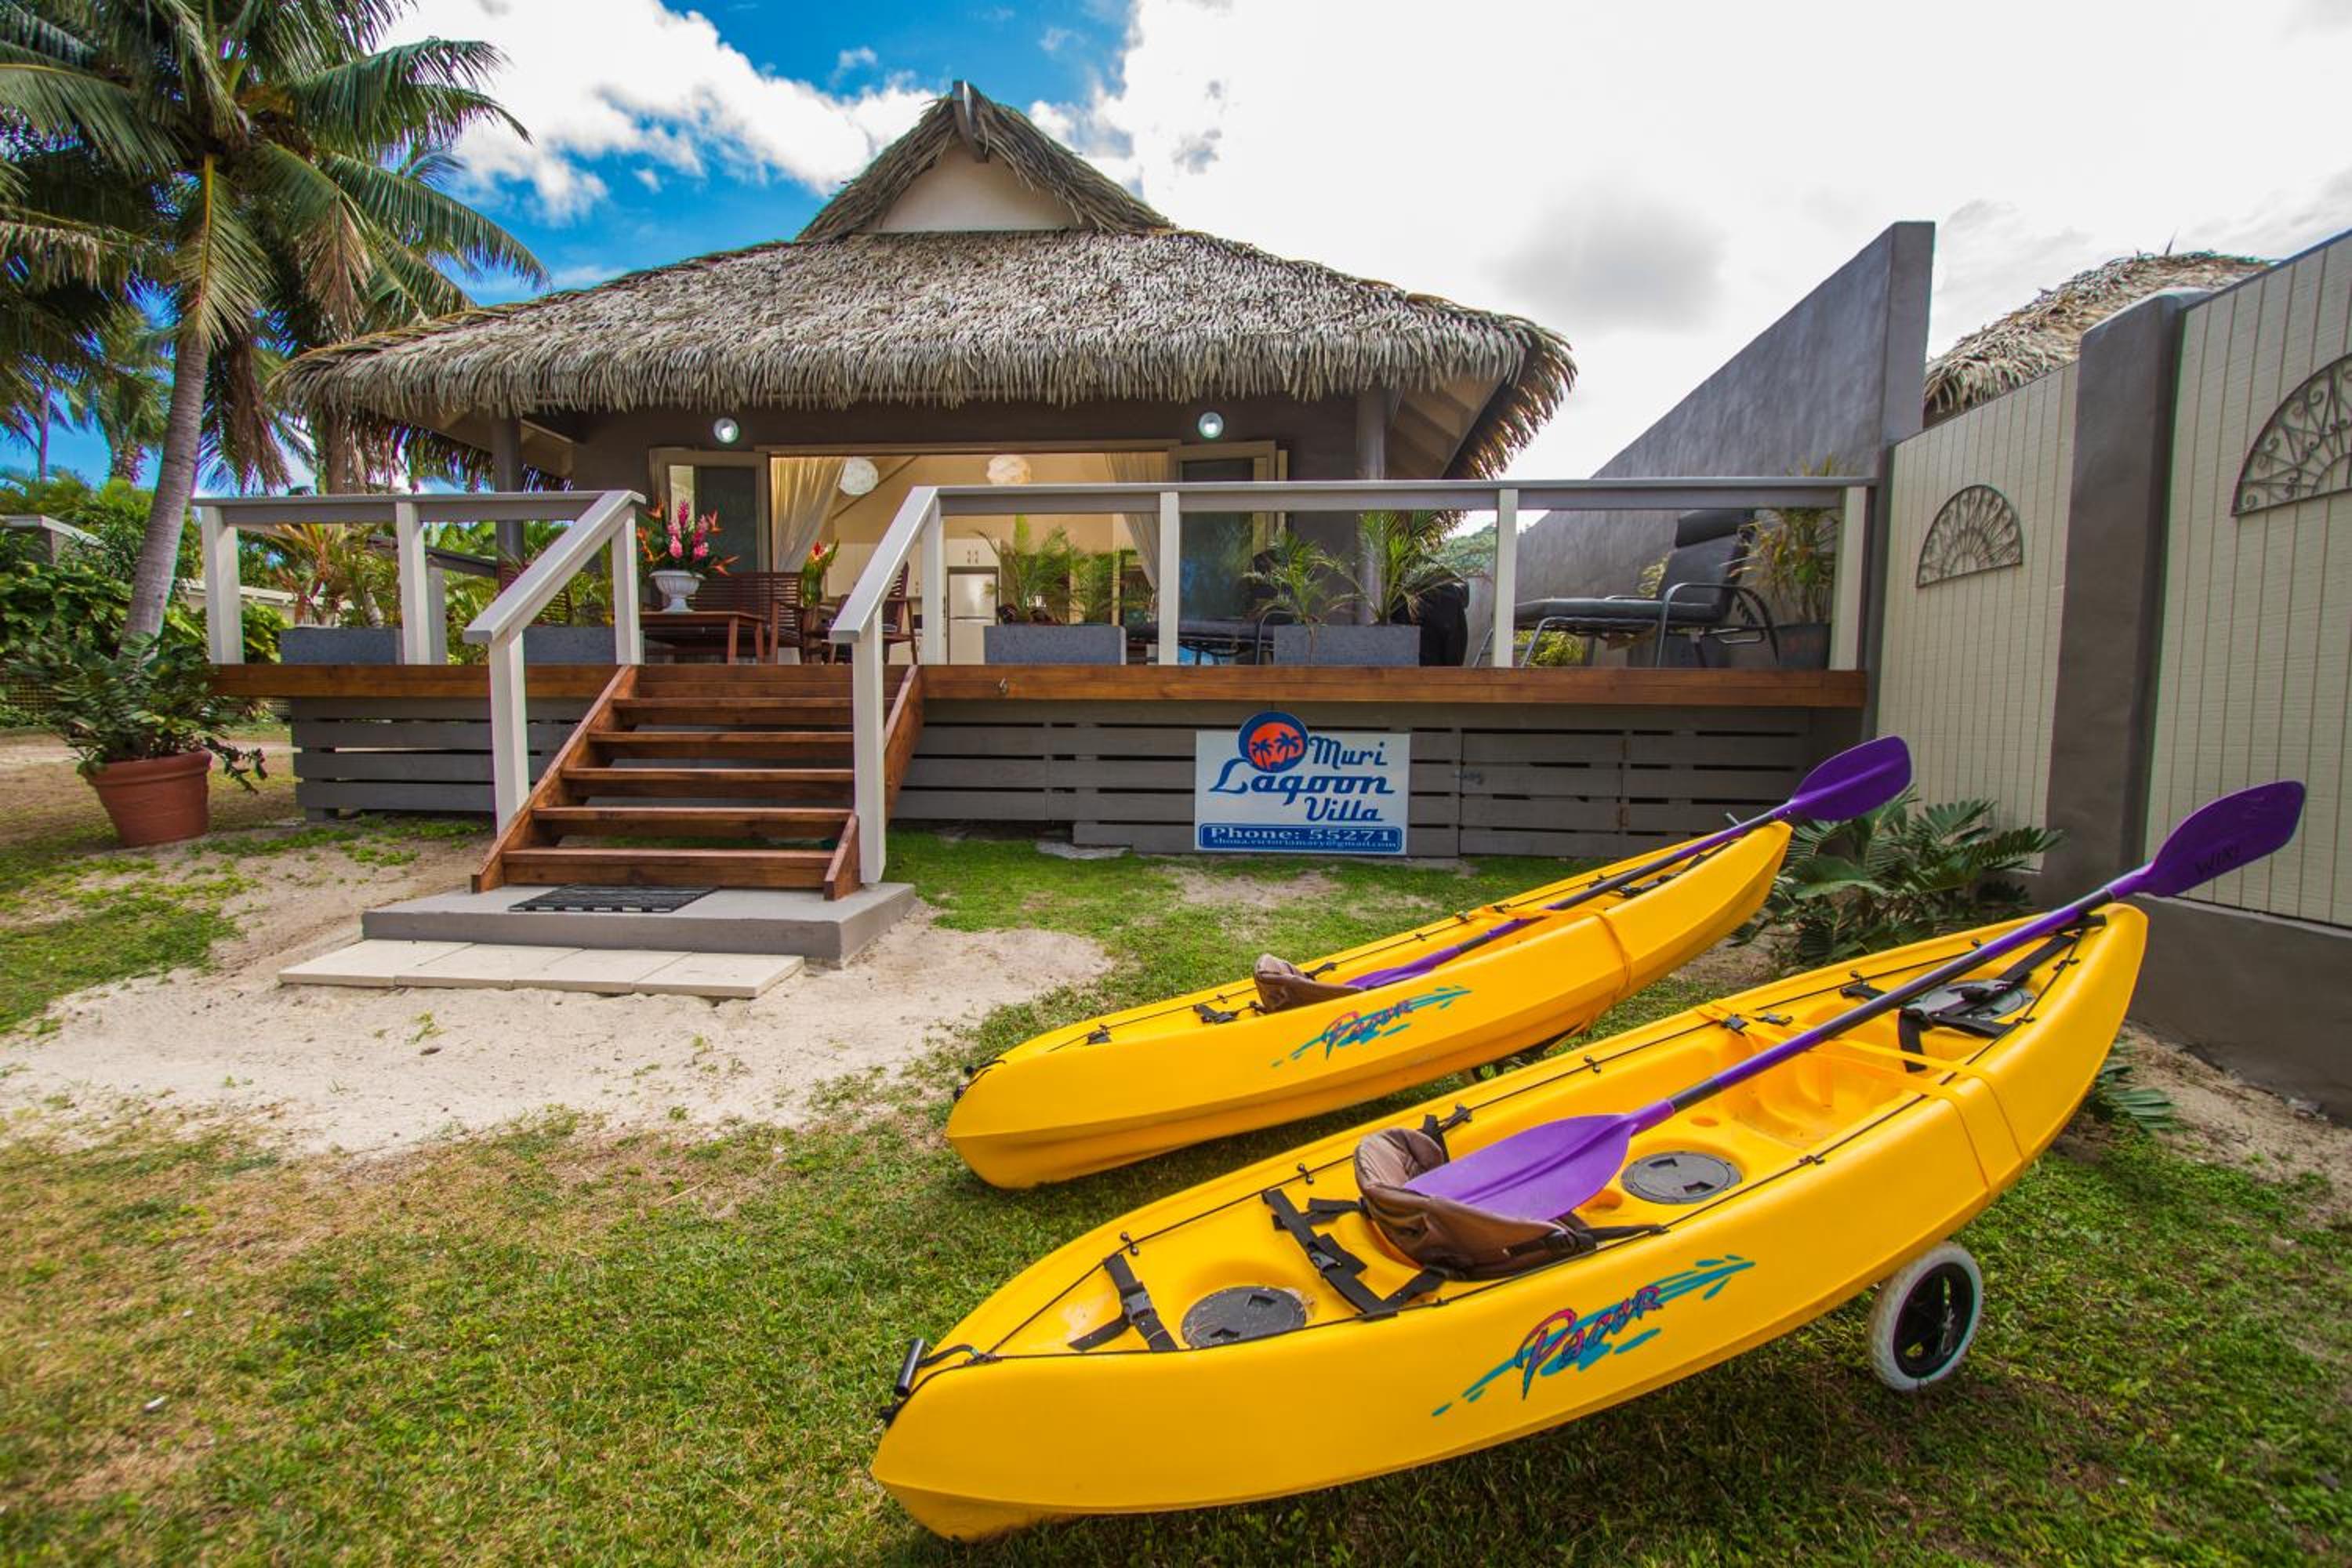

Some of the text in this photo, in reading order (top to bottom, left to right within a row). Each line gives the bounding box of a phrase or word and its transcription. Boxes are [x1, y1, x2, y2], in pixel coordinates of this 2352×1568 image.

[1308, 736, 1388, 769] Muri
[1209, 758, 1396, 807] Lagoon
[1305, 797, 1385, 822] Villa
[1210, 827, 1390, 842] Phone: 55271
